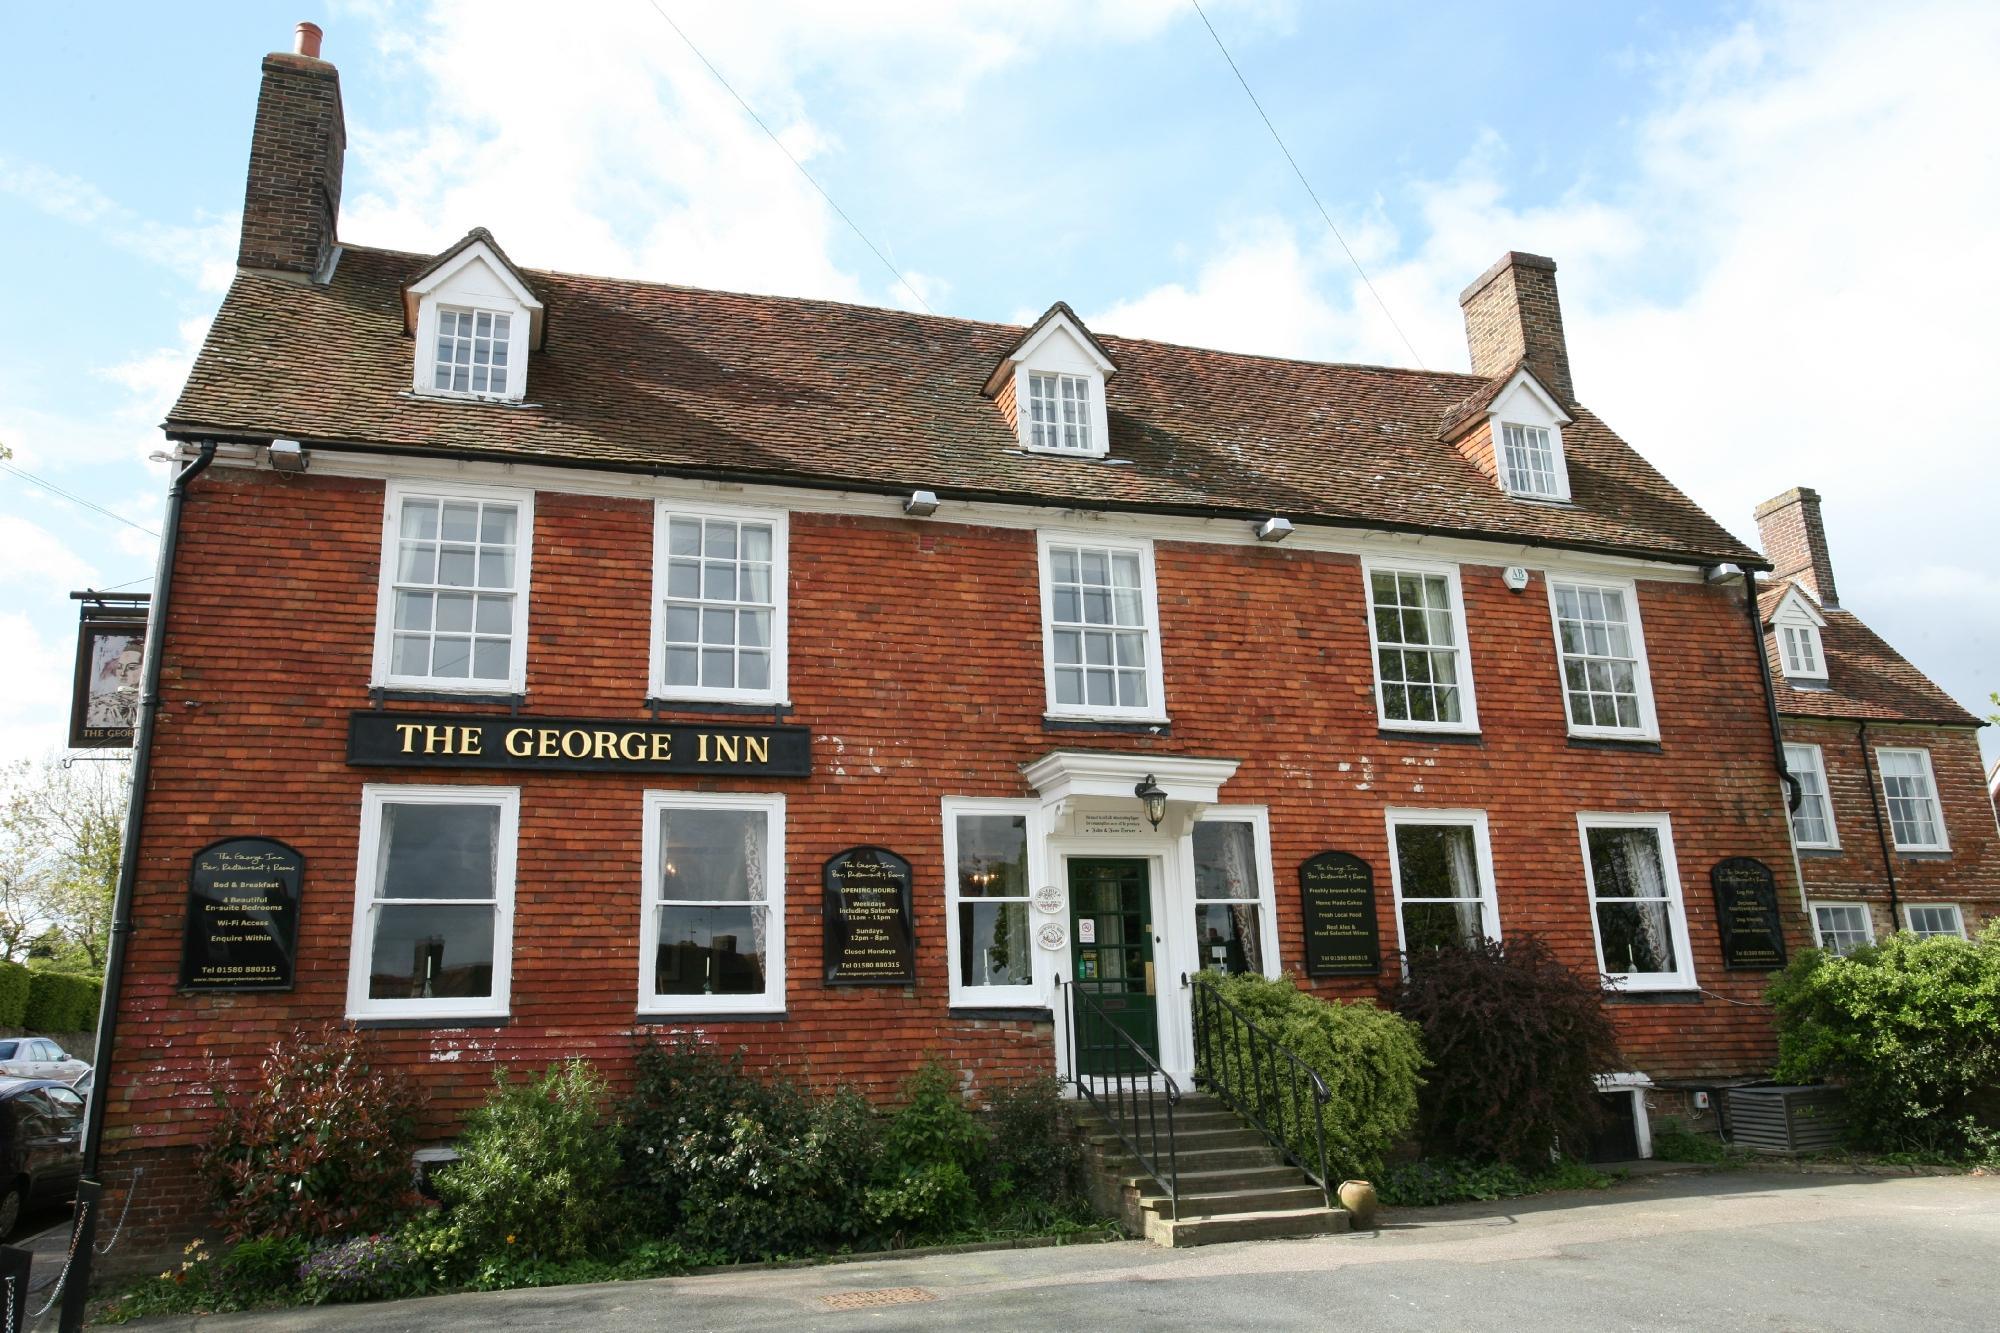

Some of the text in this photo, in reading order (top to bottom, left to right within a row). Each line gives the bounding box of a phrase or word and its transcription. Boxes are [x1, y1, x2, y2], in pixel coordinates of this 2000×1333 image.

[84, 729, 134, 737] THE GEOR
[396, 724, 770, 763] THE GEORGE INN
[216, 852, 232, 860] The
[235, 853, 264, 863] George
[856, 862, 879, 871] George
